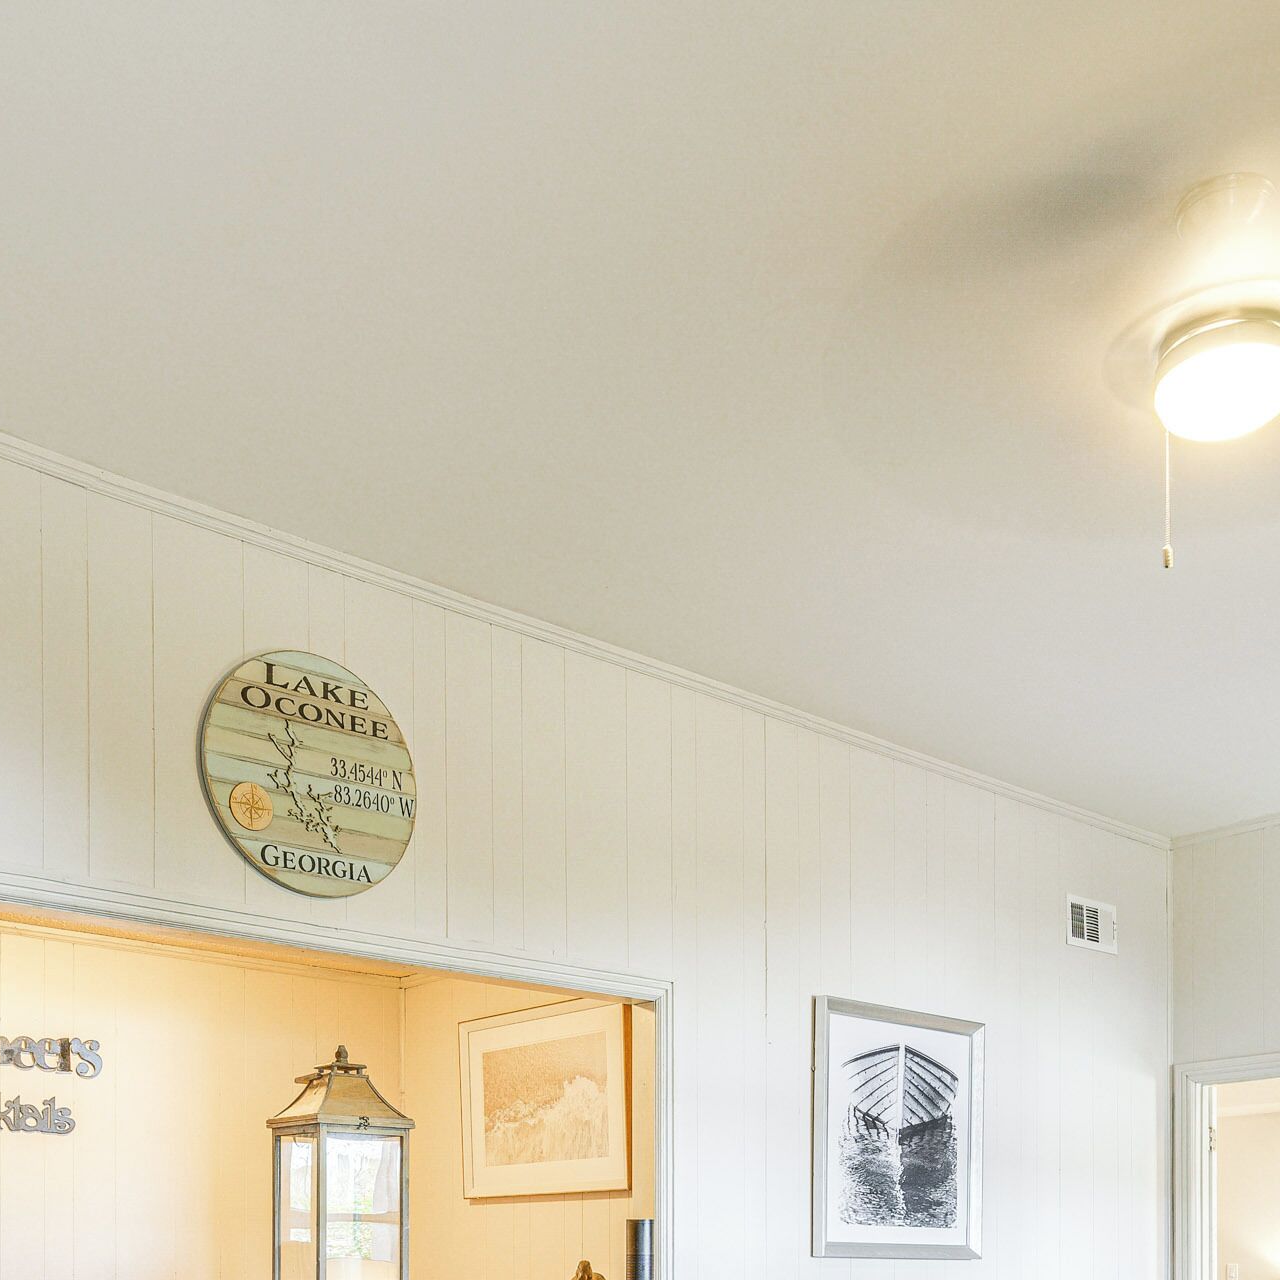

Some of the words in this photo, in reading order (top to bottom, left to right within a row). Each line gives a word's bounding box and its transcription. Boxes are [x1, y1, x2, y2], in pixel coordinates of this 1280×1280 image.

[263, 661, 369, 711] LAKE
[240, 685, 389, 740] OCONEE
[392, 770, 402, 791] N
[398, 796, 414, 818] W
[260, 844, 372, 883] GEORGIA
